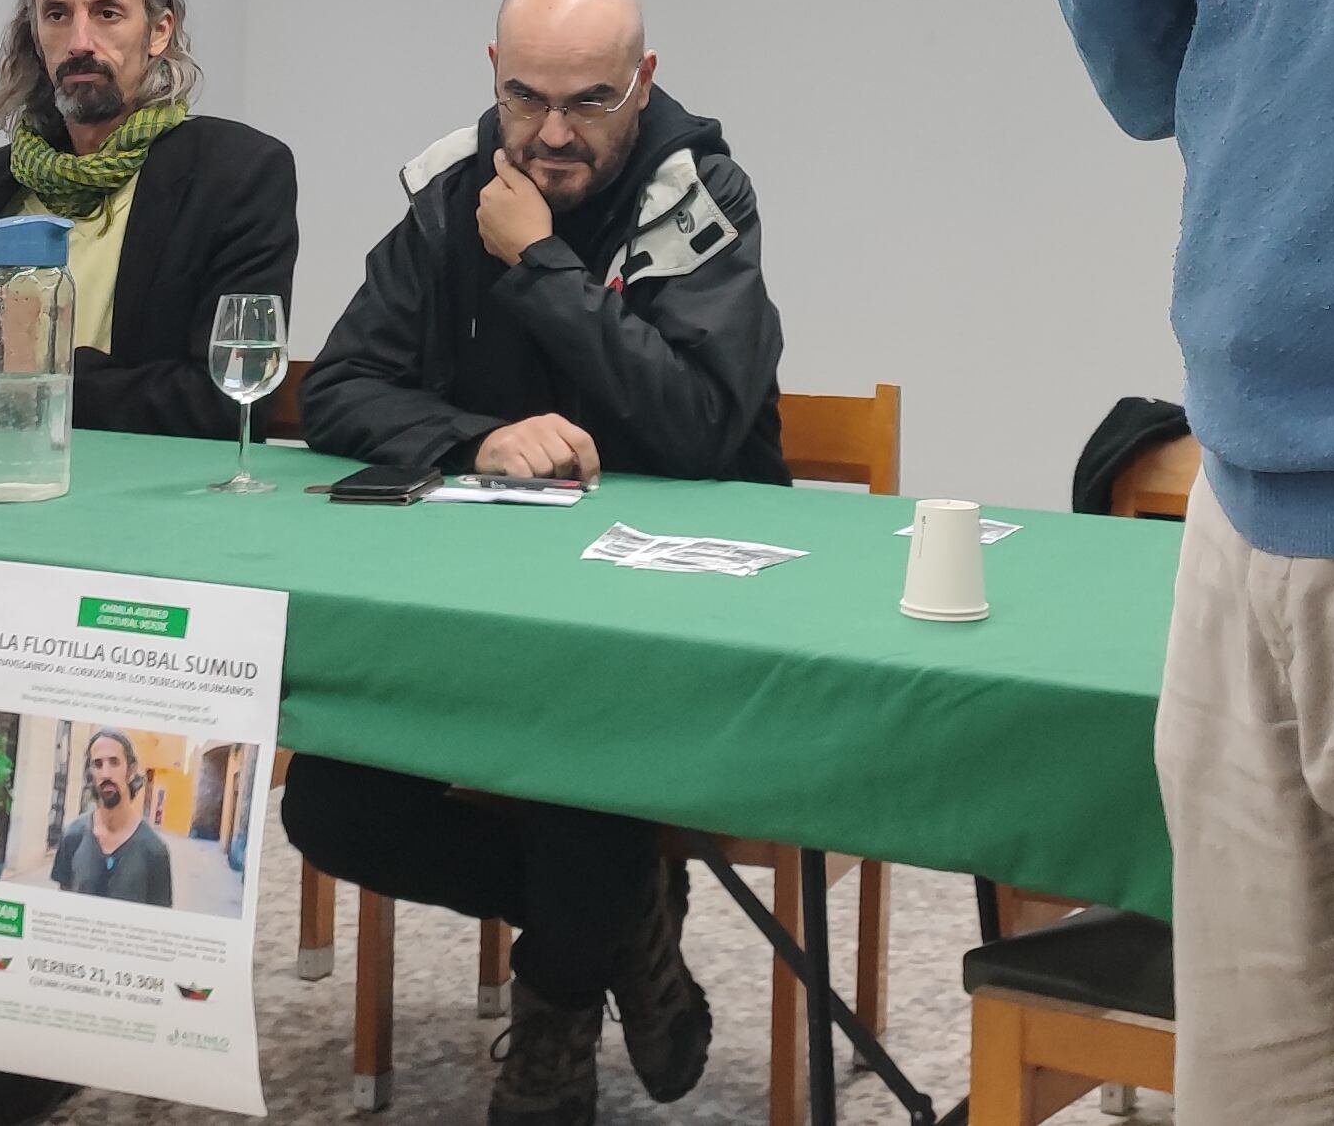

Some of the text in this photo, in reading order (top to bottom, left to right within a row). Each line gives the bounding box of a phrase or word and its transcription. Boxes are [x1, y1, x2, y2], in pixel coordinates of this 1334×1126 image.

[23, 635, 106, 663] FLOTILLA
[111, 645, 181, 673] GLOBAL
[185, 653, 259, 681] SUMUD
[27, 955, 87, 979] VIERNES
